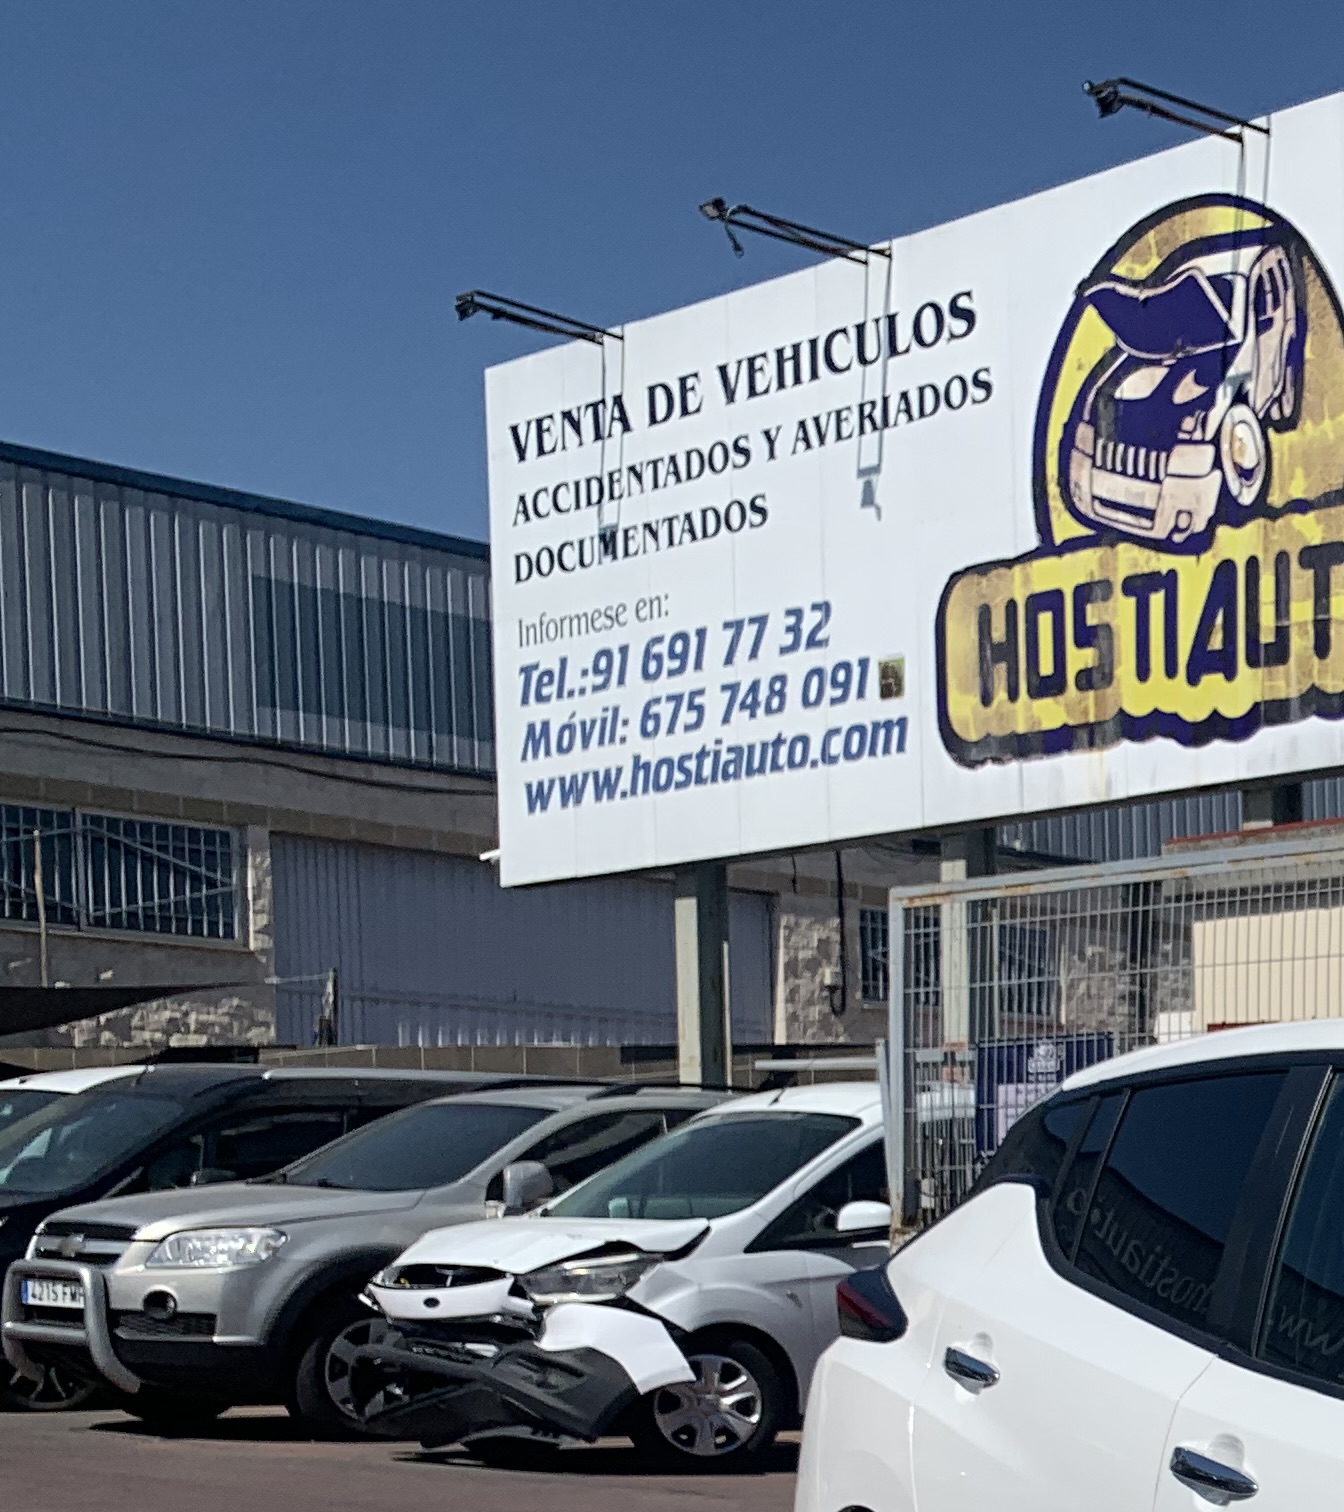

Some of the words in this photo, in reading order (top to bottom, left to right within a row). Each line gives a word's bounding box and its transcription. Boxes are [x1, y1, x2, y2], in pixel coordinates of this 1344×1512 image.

[509, 394, 633, 463] VENTA
[646, 371, 703, 427] DE
[717, 291, 976, 405] VEHICULOS
[512, 434, 750, 527] ACCIDENTADOS
[762, 424, 783, 461] Y
[791, 367, 993, 457] AVERIADOS
[514, 493, 768, 584] DOCUMENTADOS
[518, 602, 628, 648] Informese
[635, 592, 670, 622] en:
[641, 627, 708, 682] 691
[722, 613, 769, 667] 77
[779, 601, 831, 655] 32
[521, 706, 629, 763] Móvil:
[639, 687, 706, 739] 675
[719, 674, 788, 725] 748
[801, 657, 870, 709] 091
[524, 716, 908, 816] www.hostiauto.com
